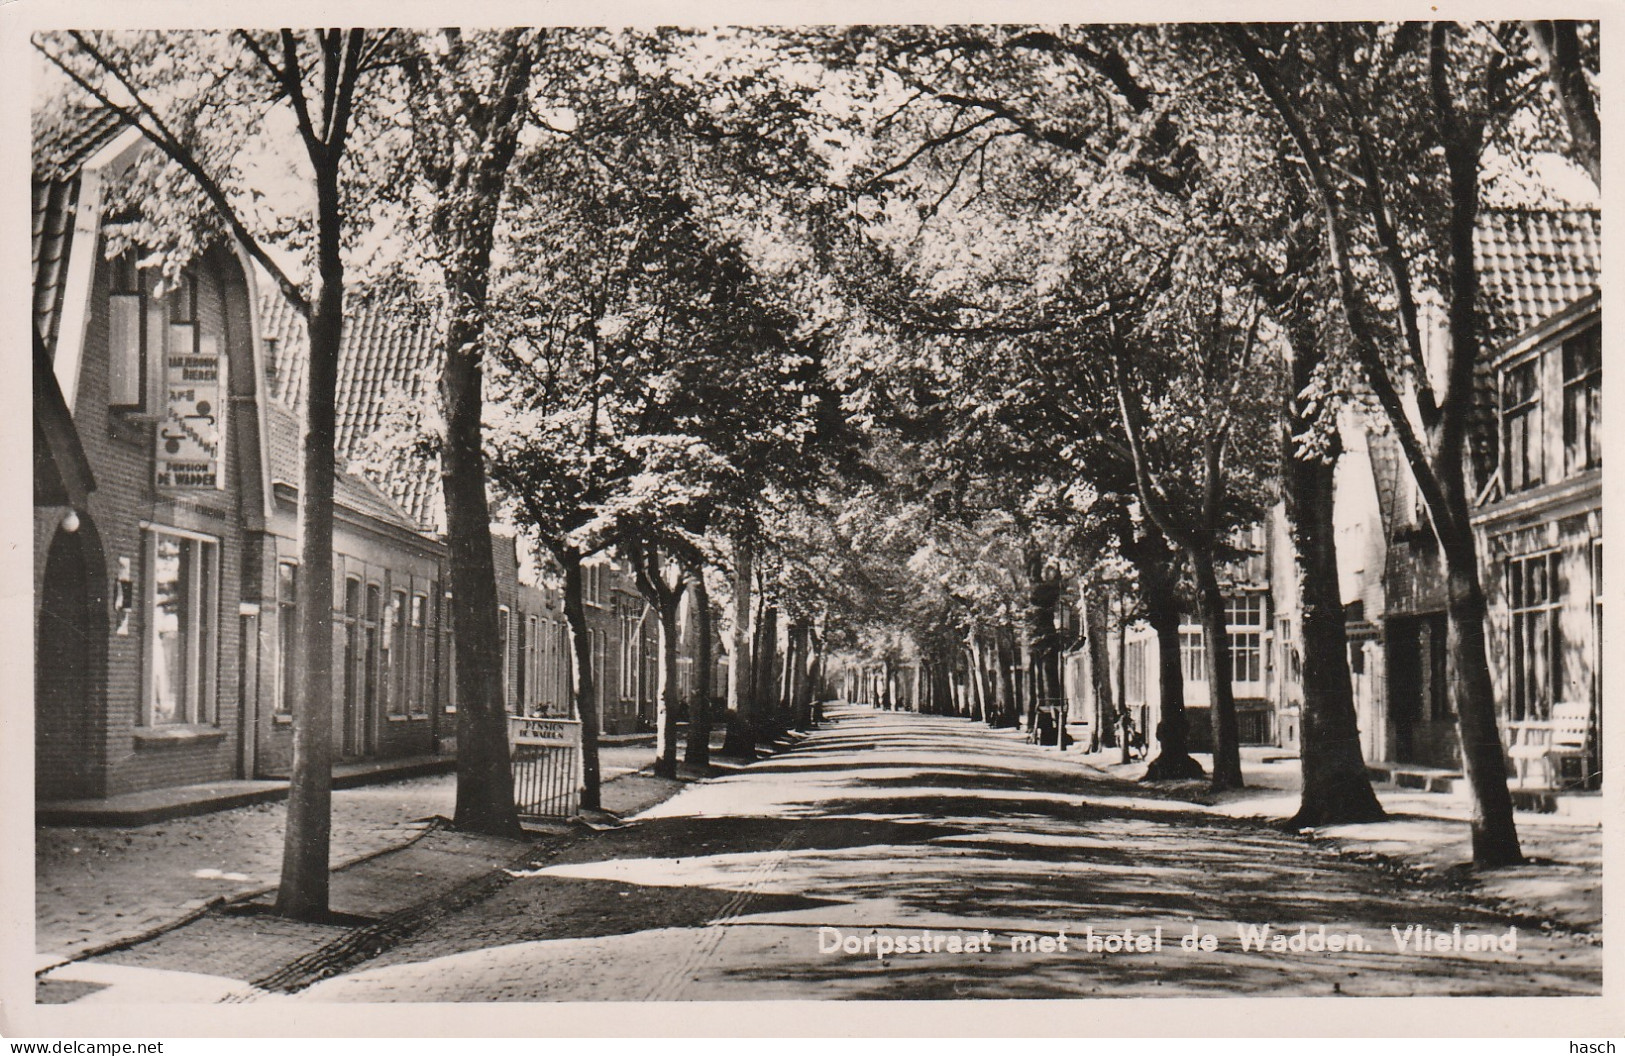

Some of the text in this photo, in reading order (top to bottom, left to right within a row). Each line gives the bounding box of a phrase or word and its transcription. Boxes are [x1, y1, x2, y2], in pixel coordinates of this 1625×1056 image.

[166, 462, 208, 472] PENSION
[158, 472, 217, 486] DE WADDEN
[525, 722, 564, 731] PENSION
